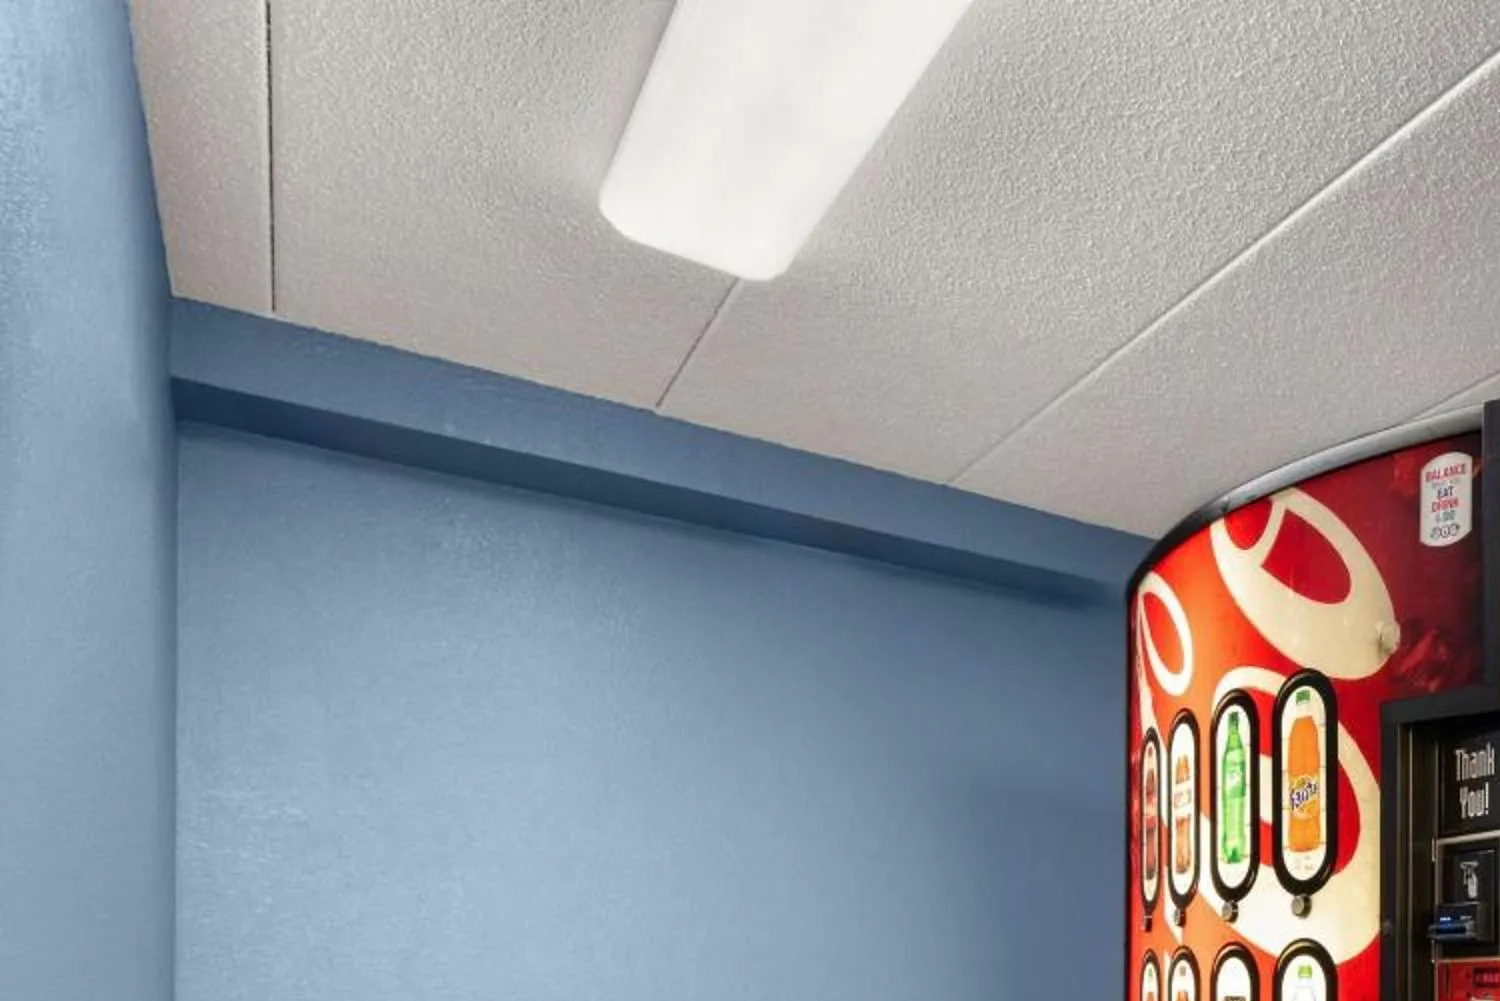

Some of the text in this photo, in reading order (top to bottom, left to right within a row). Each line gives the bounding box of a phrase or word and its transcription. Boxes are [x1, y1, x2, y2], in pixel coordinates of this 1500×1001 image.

[1438, 486, 1454, 499] EAT
[1455, 741, 1495, 782] Thank
[1460, 782, 1489, 818] You!
